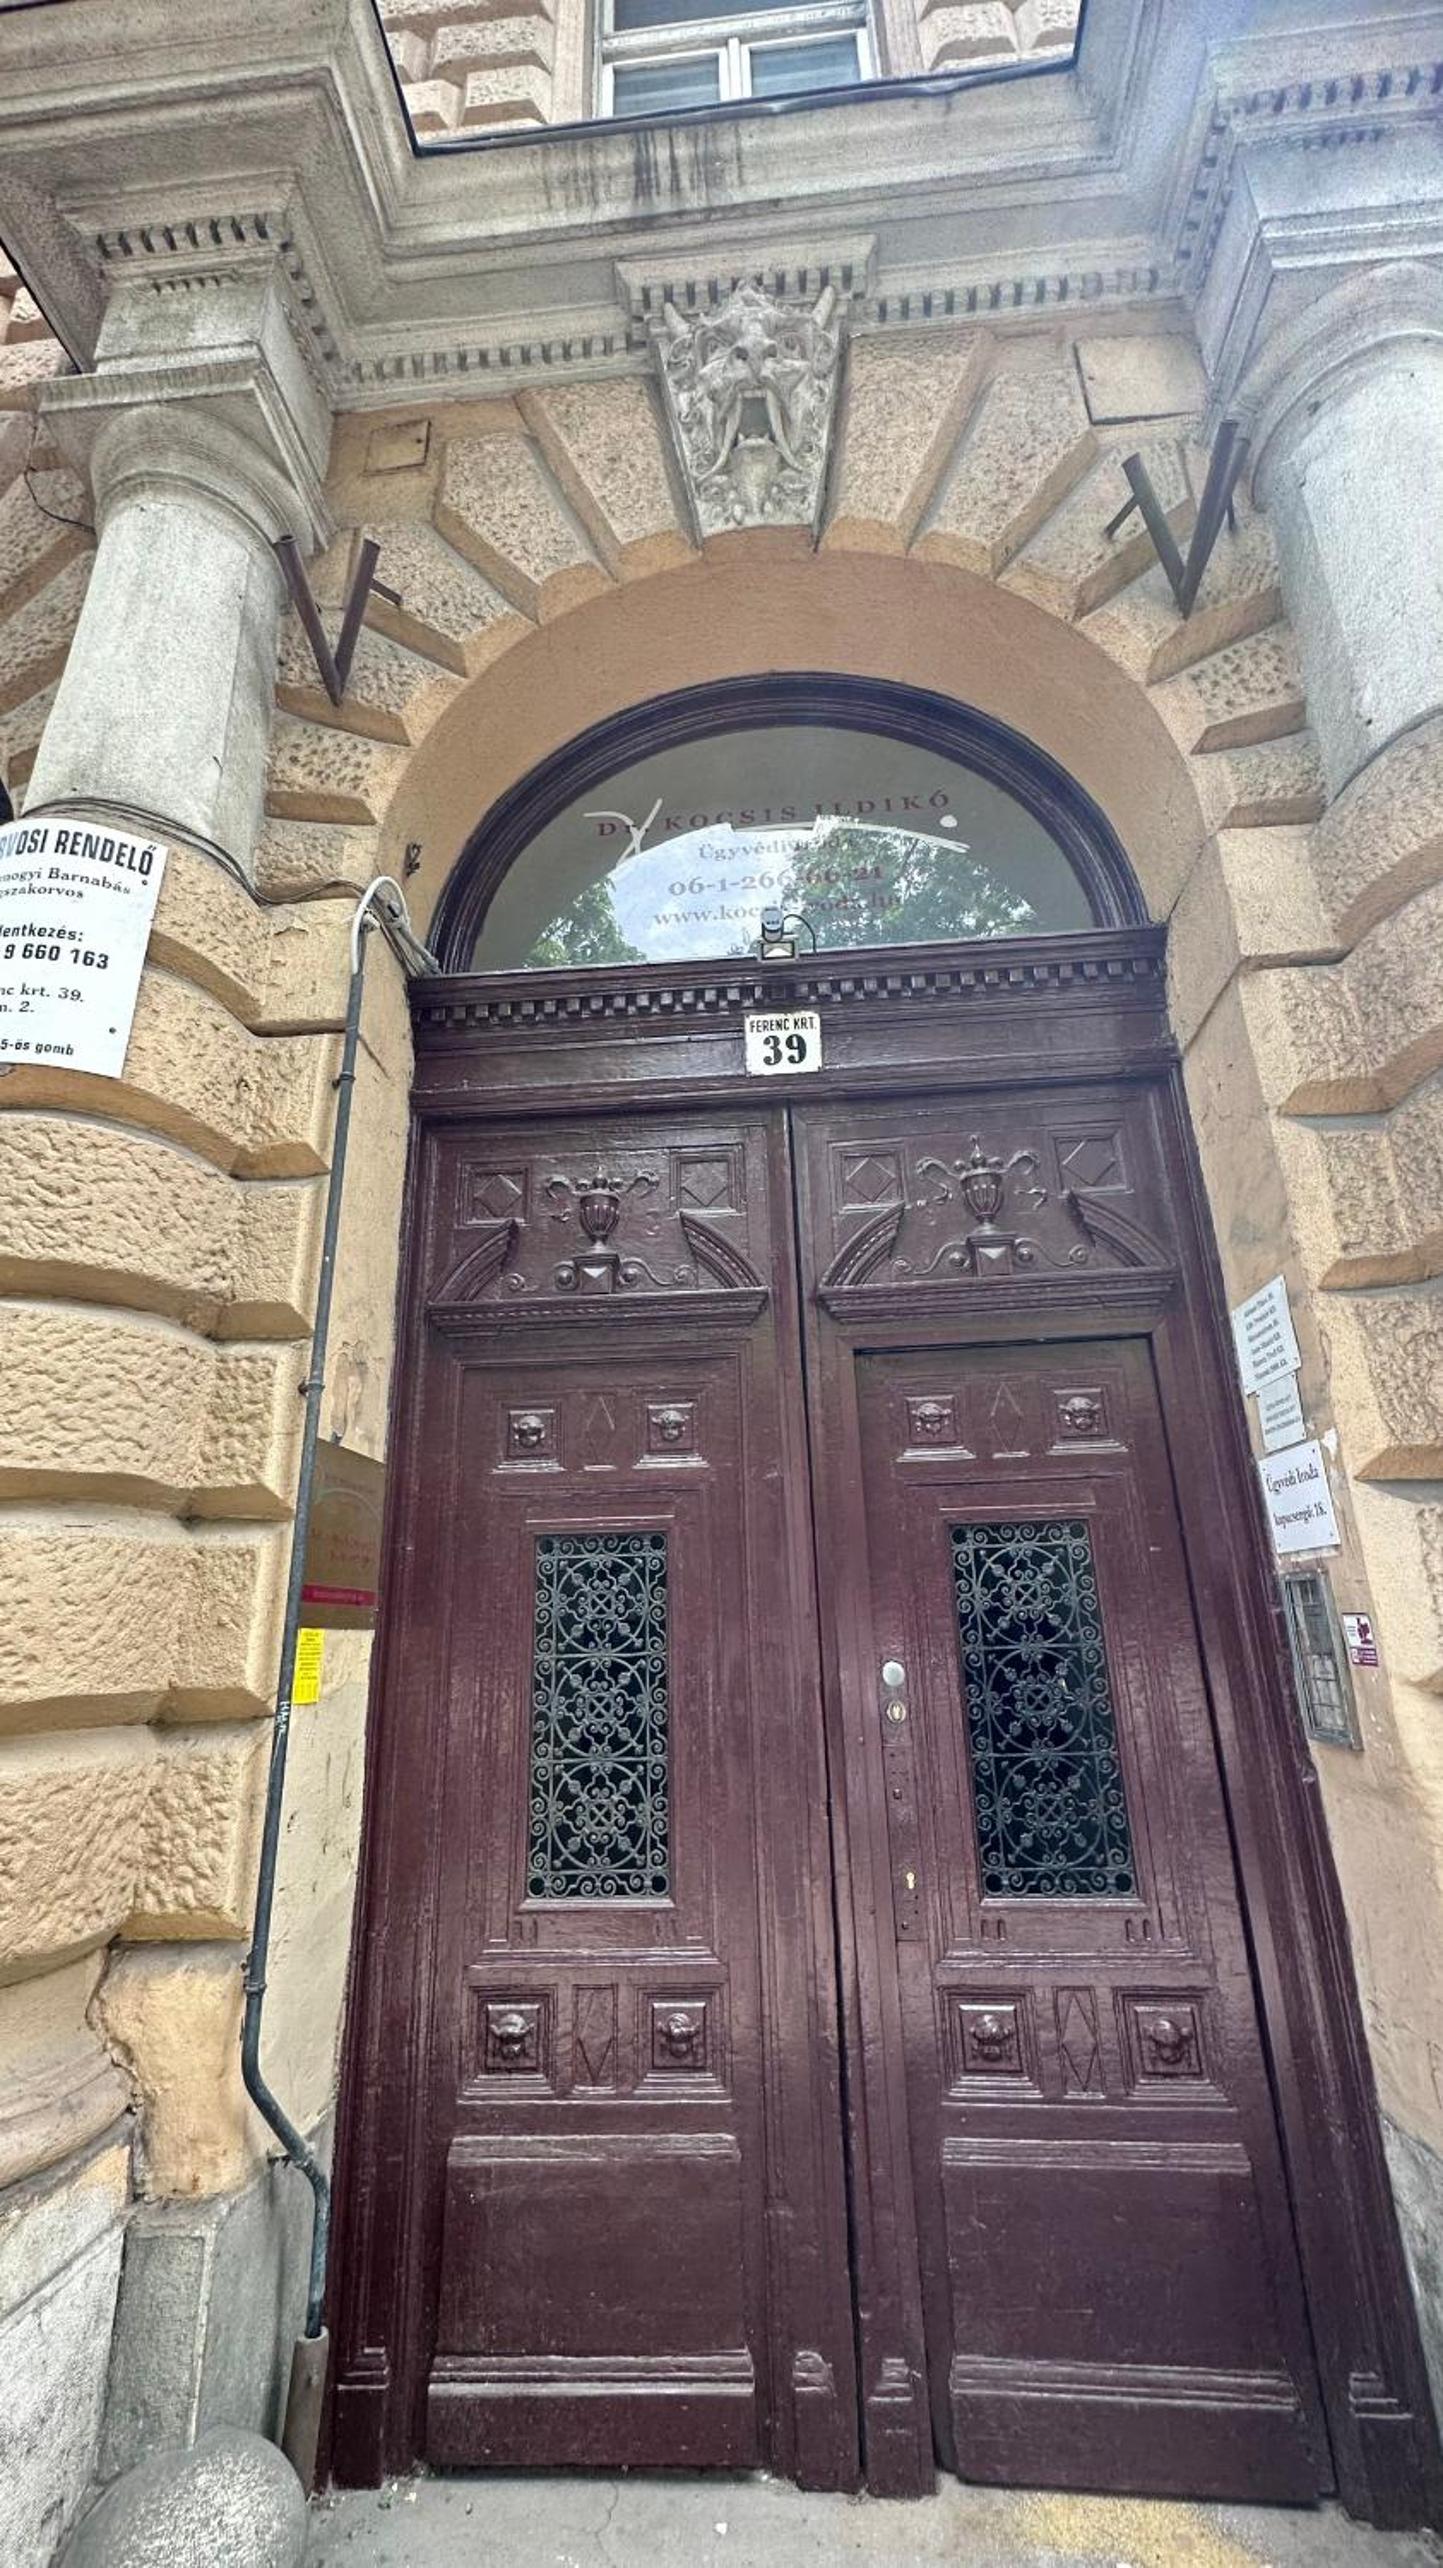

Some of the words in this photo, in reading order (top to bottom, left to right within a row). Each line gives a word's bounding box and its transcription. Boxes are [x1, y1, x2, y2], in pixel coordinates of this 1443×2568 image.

[665, 804, 796, 831] KOCSIS
[815, 789, 949, 816] ILDIKÓ
[54, 829, 157, 876] RENDELŐ
[48, 867, 131, 894] Barnabás
[22, 943, 61, 961] 660
[70, 948, 109, 970] 163
[20, 982, 50, 998] krt.
[58, 987, 84, 1003] 39.
[19, 1000, 35, 1013] 2.
[749, 1018, 790, 1033] FERENC
[793, 1016, 818, 1031] KRT.
[35, 1043, 74, 1056] gomb
[762, 1033, 807, 1066] 39
